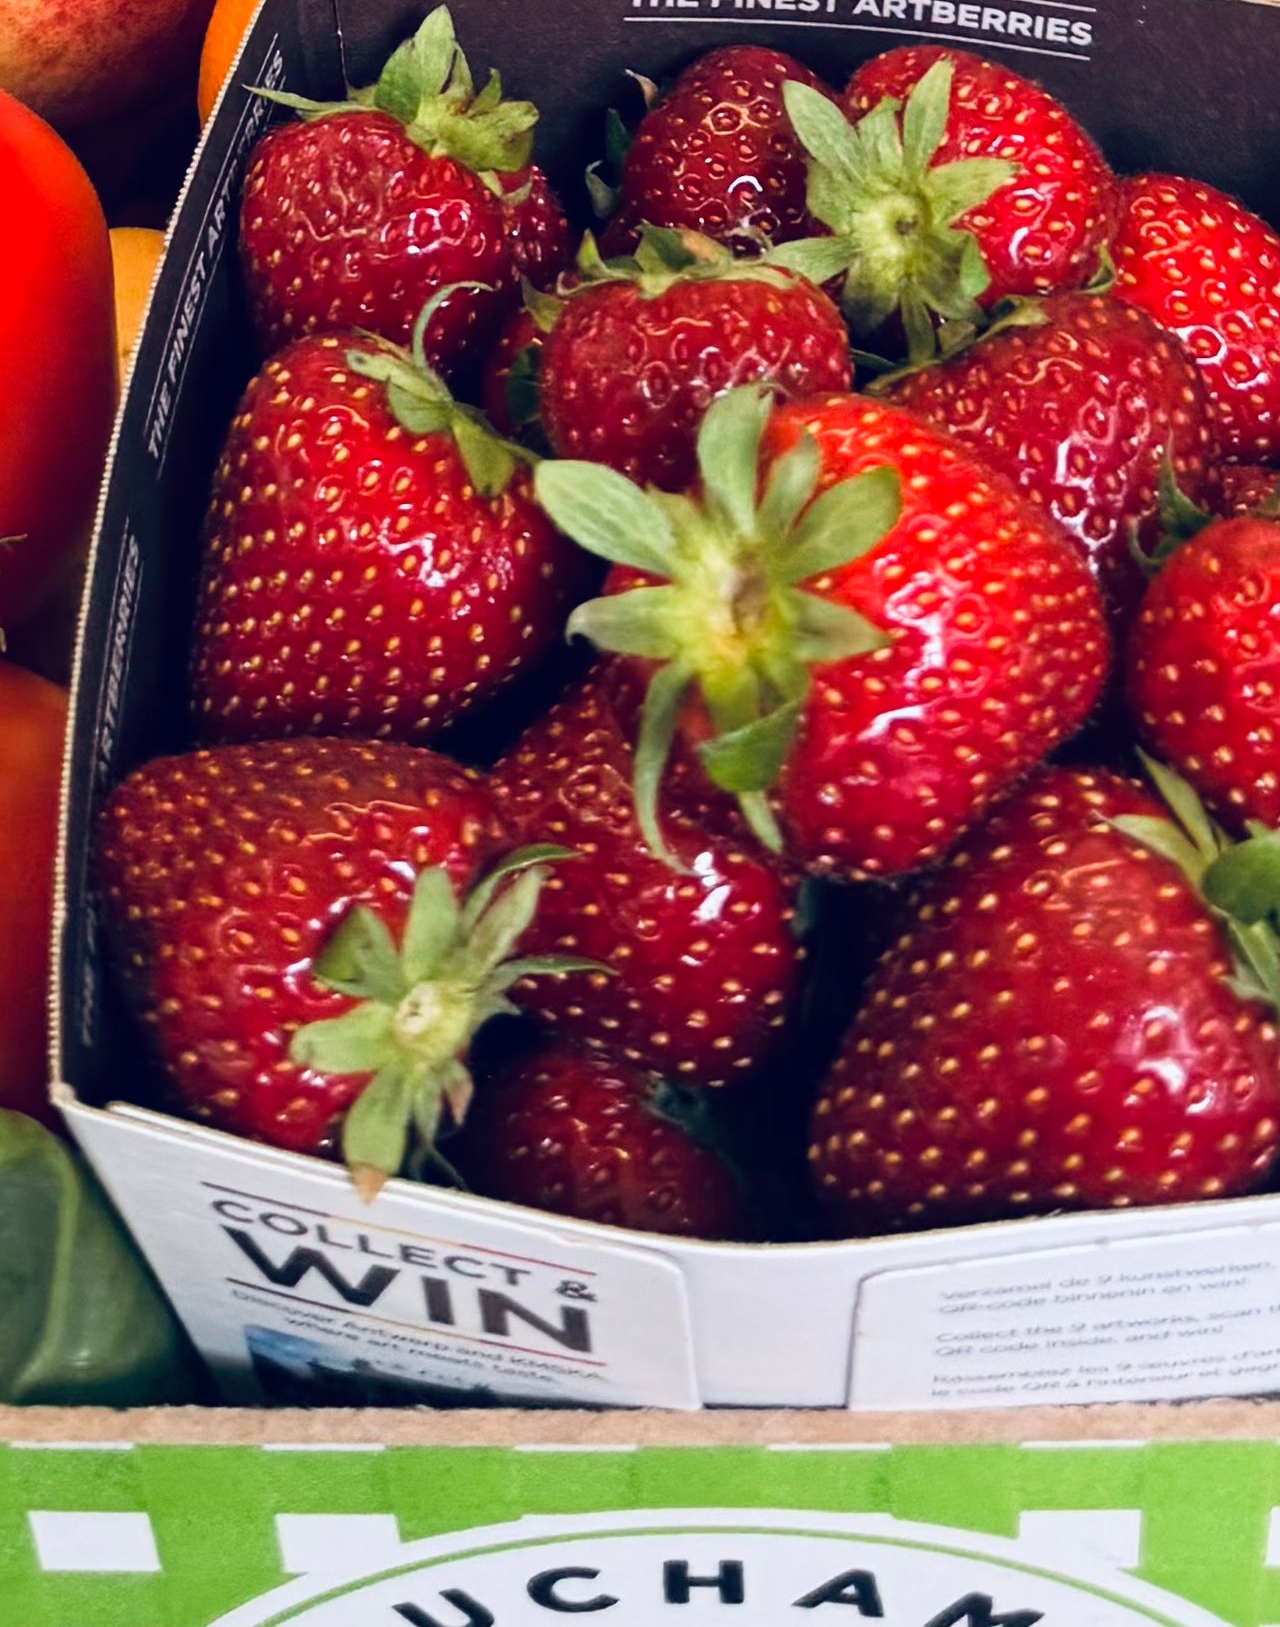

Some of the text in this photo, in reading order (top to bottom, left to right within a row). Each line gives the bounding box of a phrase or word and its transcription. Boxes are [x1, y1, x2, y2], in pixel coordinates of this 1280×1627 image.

[147, 381, 170, 460] THE
[168, 251, 206, 384] FINEST
[211, 1200, 598, 1302] COLLECT &
[222, 1224, 592, 1353] WIN
